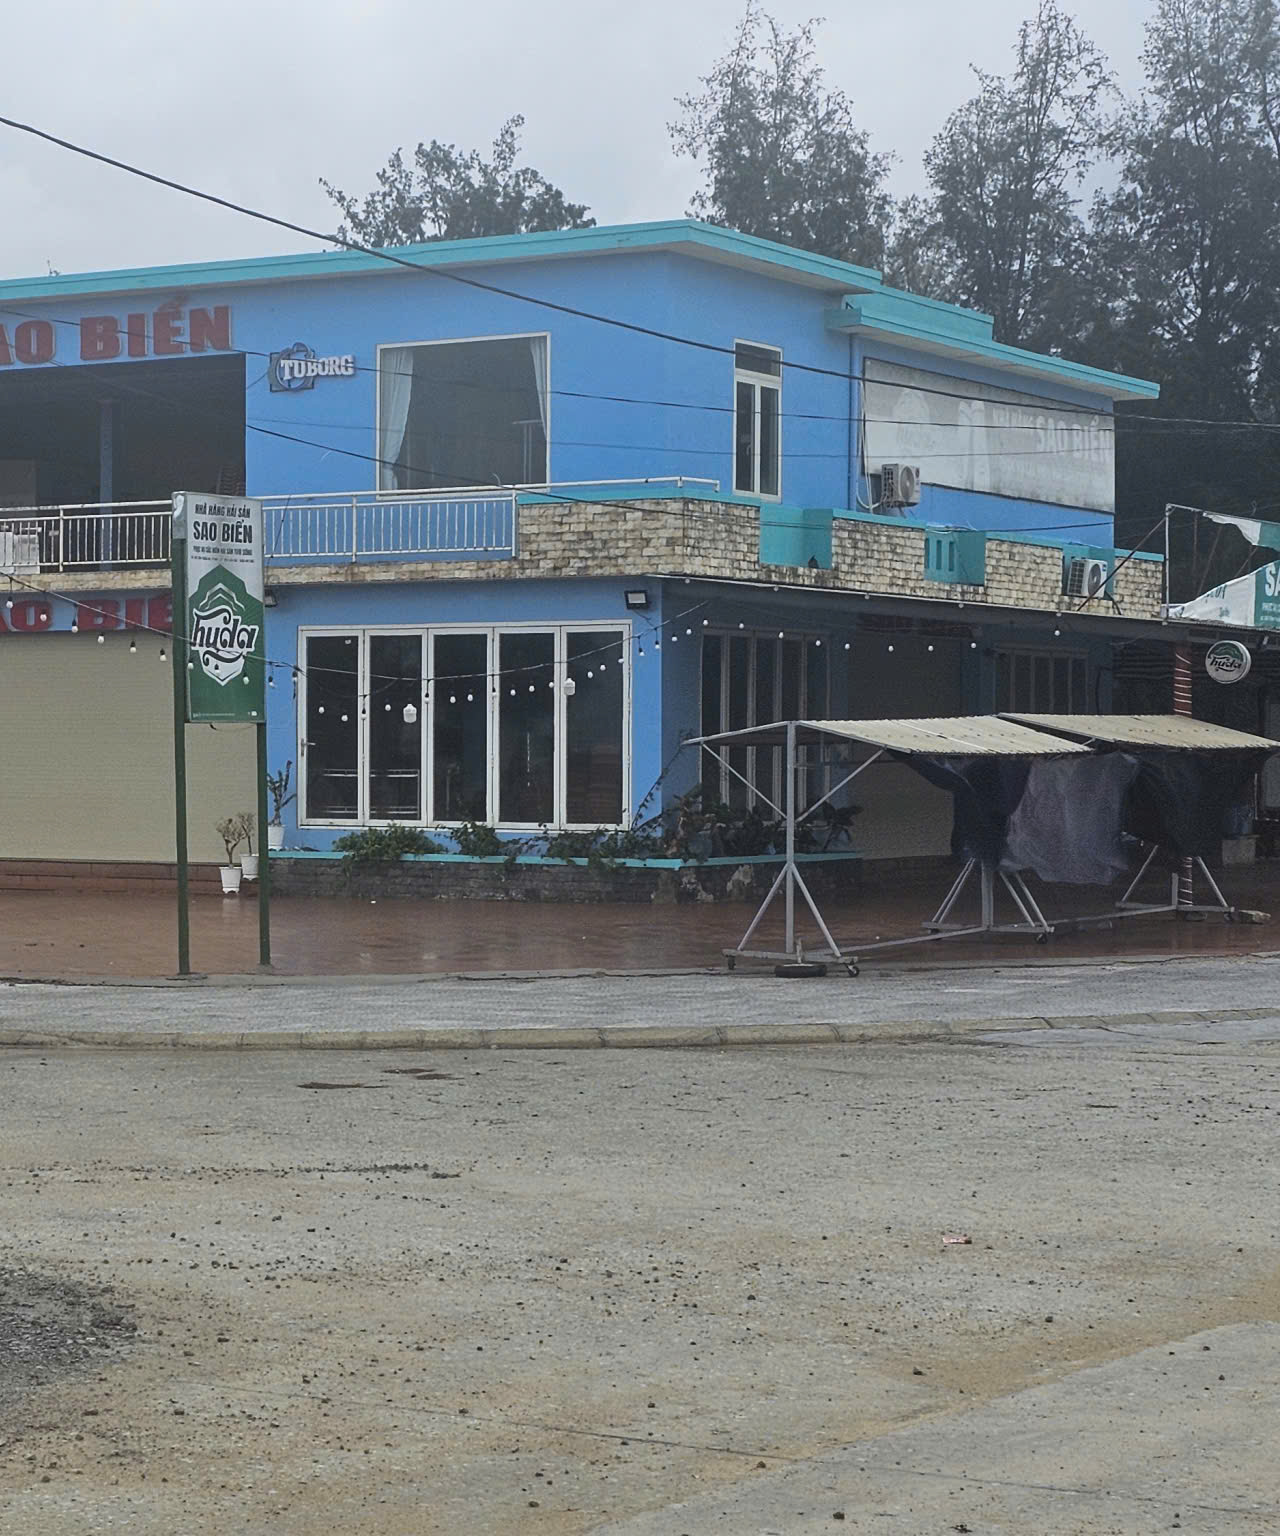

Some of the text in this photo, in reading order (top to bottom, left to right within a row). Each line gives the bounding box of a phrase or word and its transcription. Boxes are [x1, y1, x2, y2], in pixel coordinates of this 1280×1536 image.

[280, 353, 355, 380] TUBORG
[193, 519, 252, 543] SAO BIỂN
[192, 605, 259, 651] huda
[1209, 655, 1242, 670] huda
